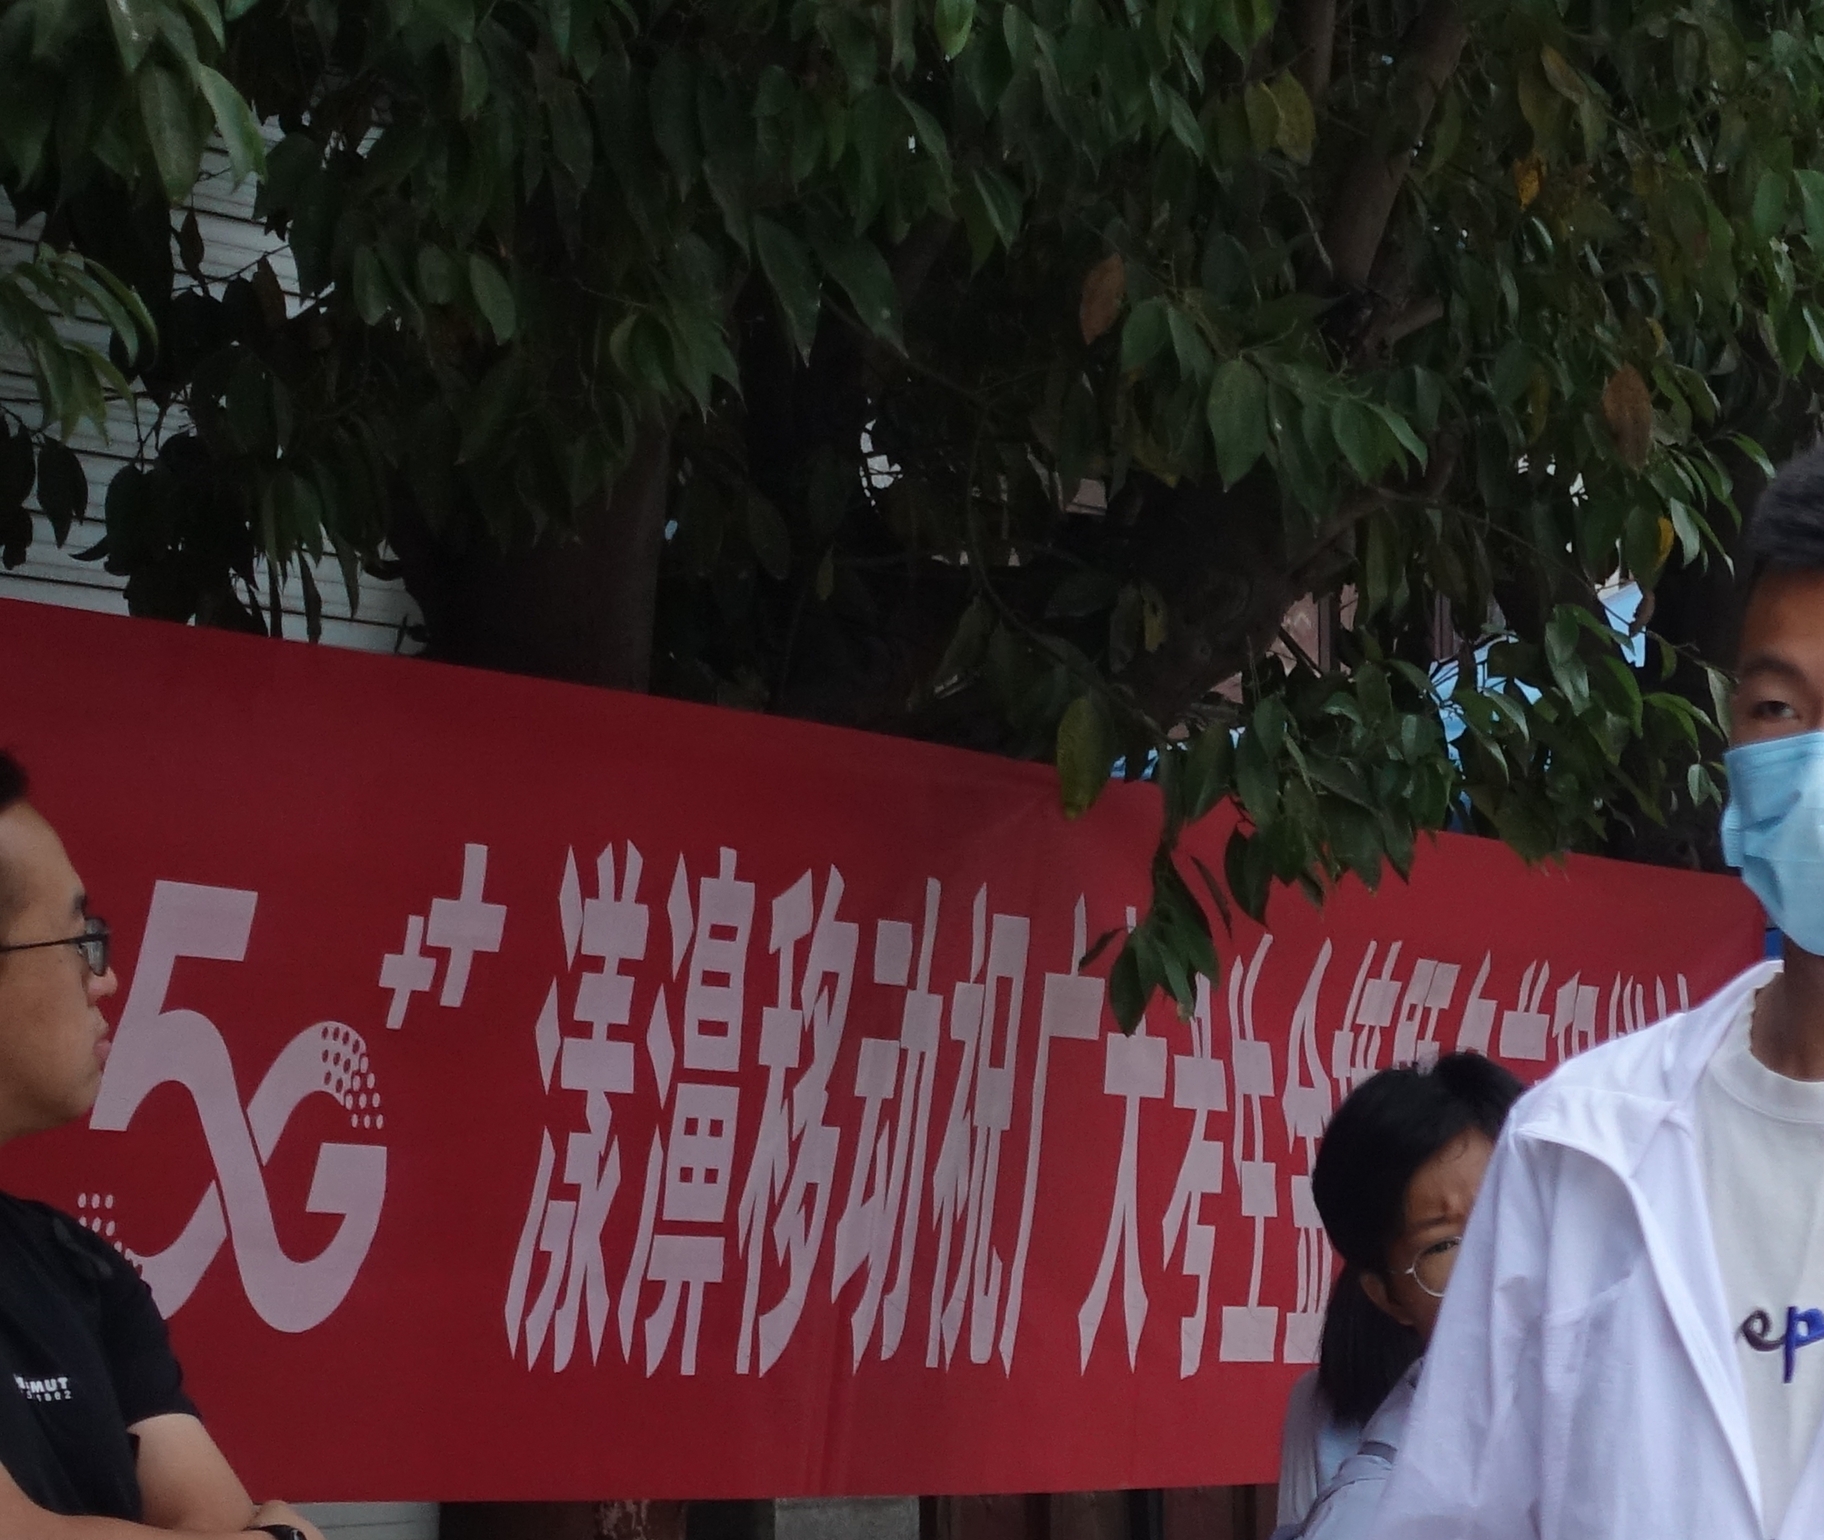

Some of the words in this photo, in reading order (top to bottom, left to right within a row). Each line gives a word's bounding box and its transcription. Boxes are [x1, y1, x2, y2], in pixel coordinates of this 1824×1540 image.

[503, 838, 1694, 1380] 漾濞移动祝广大考生金
